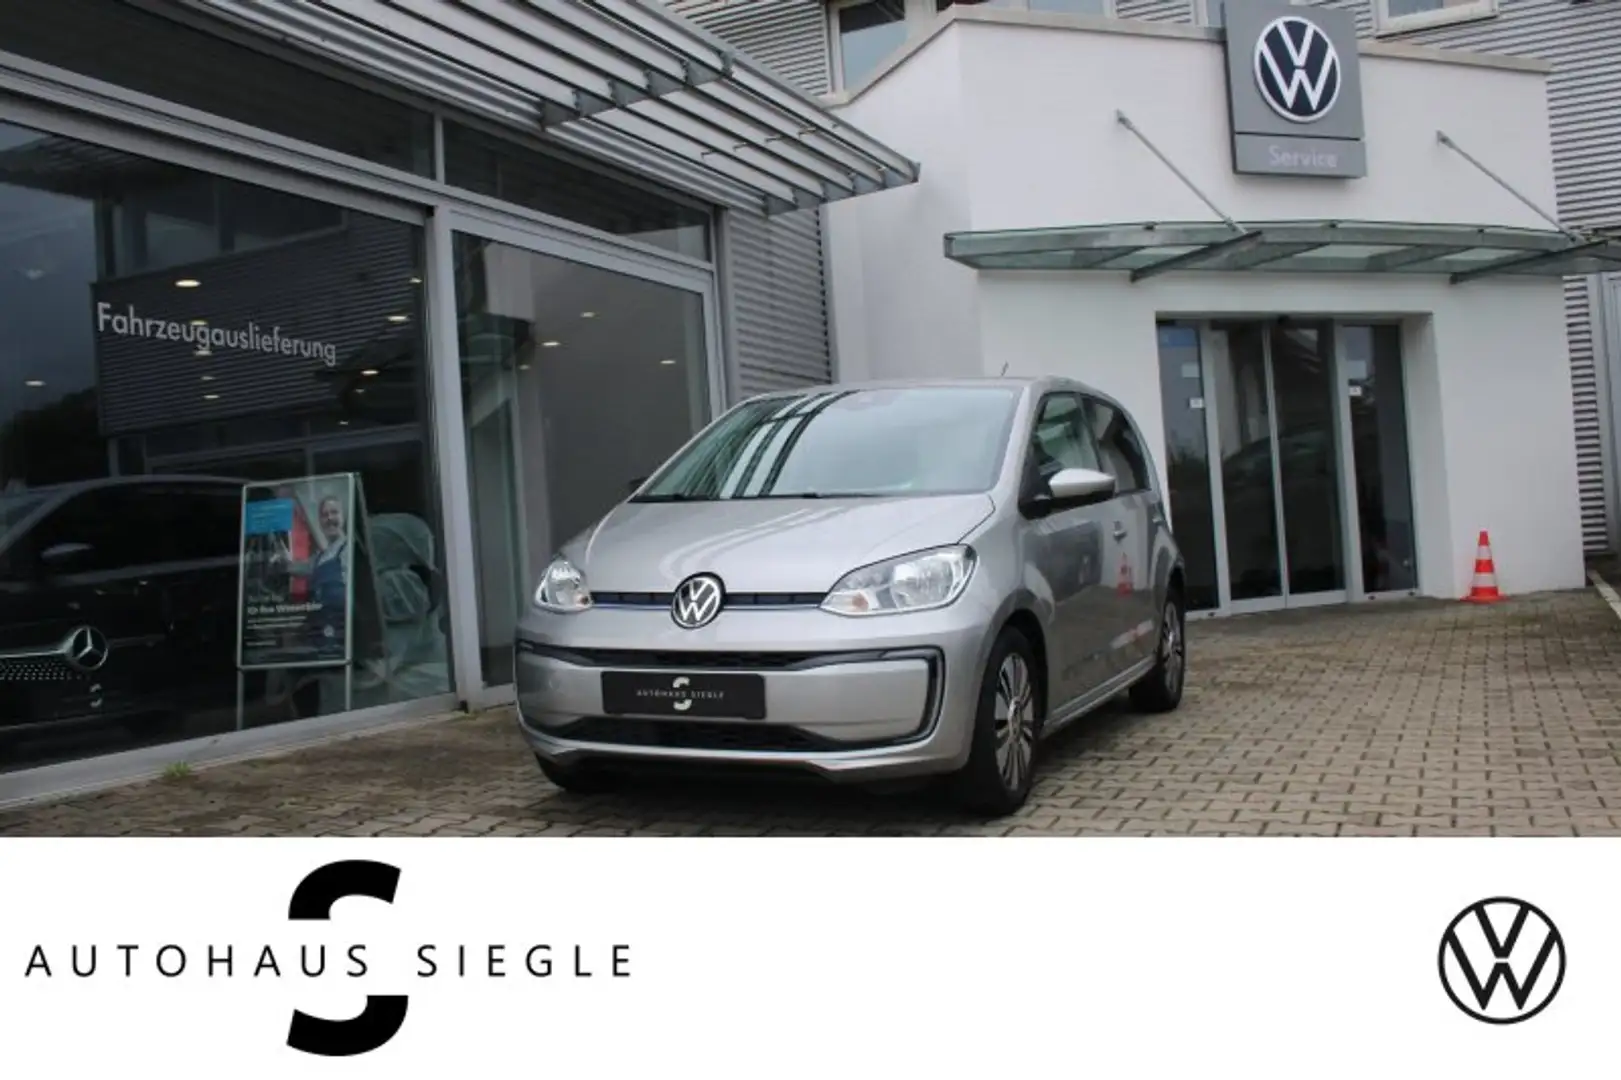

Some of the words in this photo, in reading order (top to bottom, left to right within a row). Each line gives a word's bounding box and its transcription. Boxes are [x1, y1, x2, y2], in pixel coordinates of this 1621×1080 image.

[1269, 144, 1338, 168] Service
[96, 301, 337, 367] Fahrzeugauslieferung
[635, 689, 687, 698] AUTOHAUS
[691, 690, 725, 700] SIEGLE
